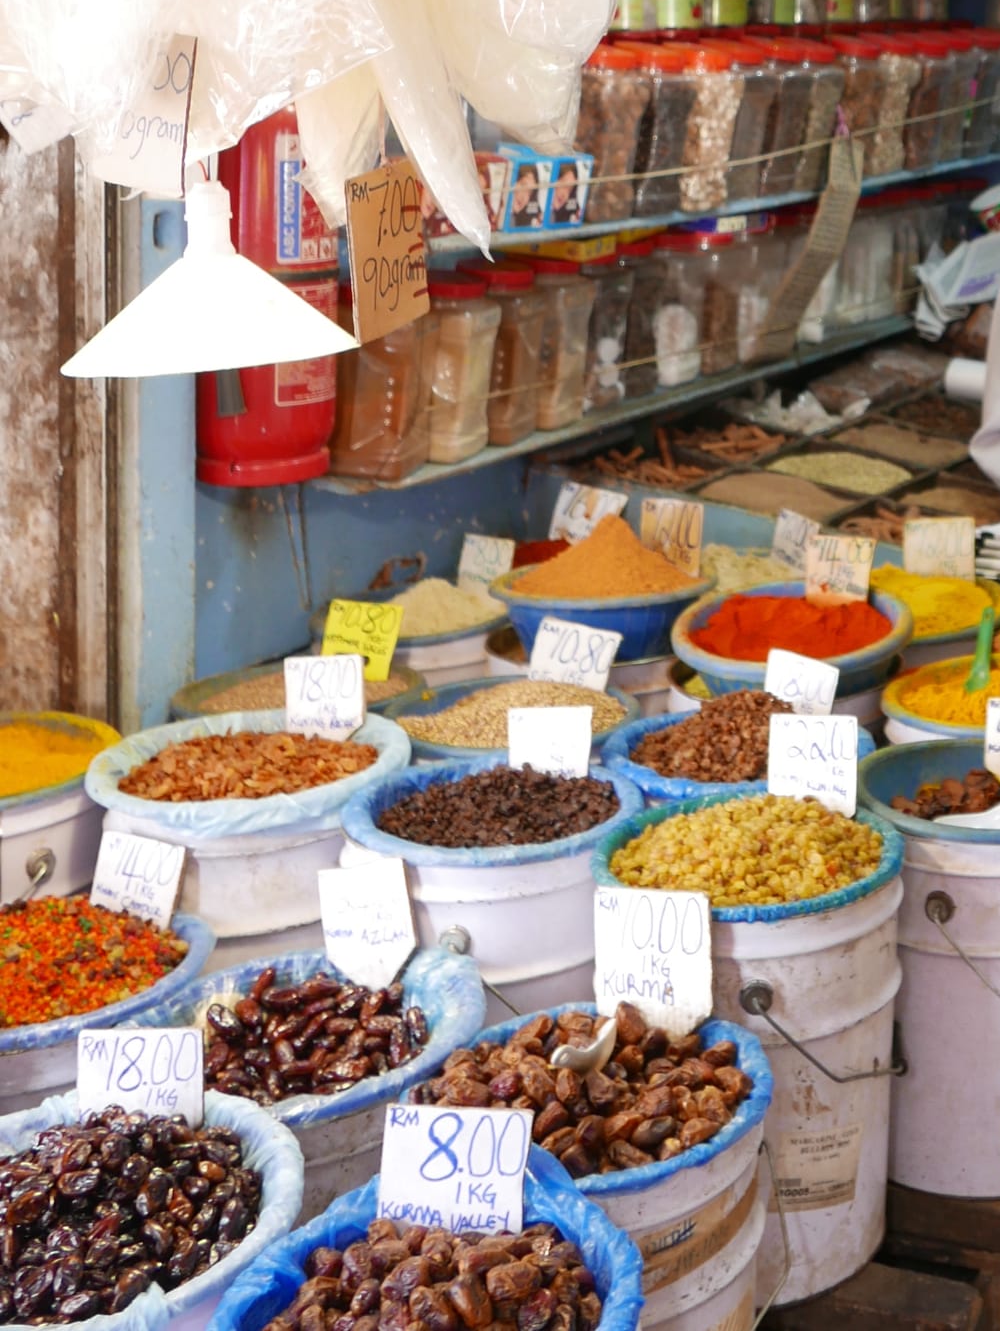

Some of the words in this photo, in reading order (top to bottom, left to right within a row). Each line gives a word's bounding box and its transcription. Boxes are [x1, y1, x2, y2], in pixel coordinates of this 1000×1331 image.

[621, 893, 704, 956] 10.00
[603, 969, 675, 1007] KURMA
[82, 1035, 109, 1062] RM
[107, 1032, 199, 1093] 18.00
[391, 1107, 420, 1128] RM
[420, 1112, 527, 1182] 8.00
[450, 1211, 510, 1235] VALLEY
